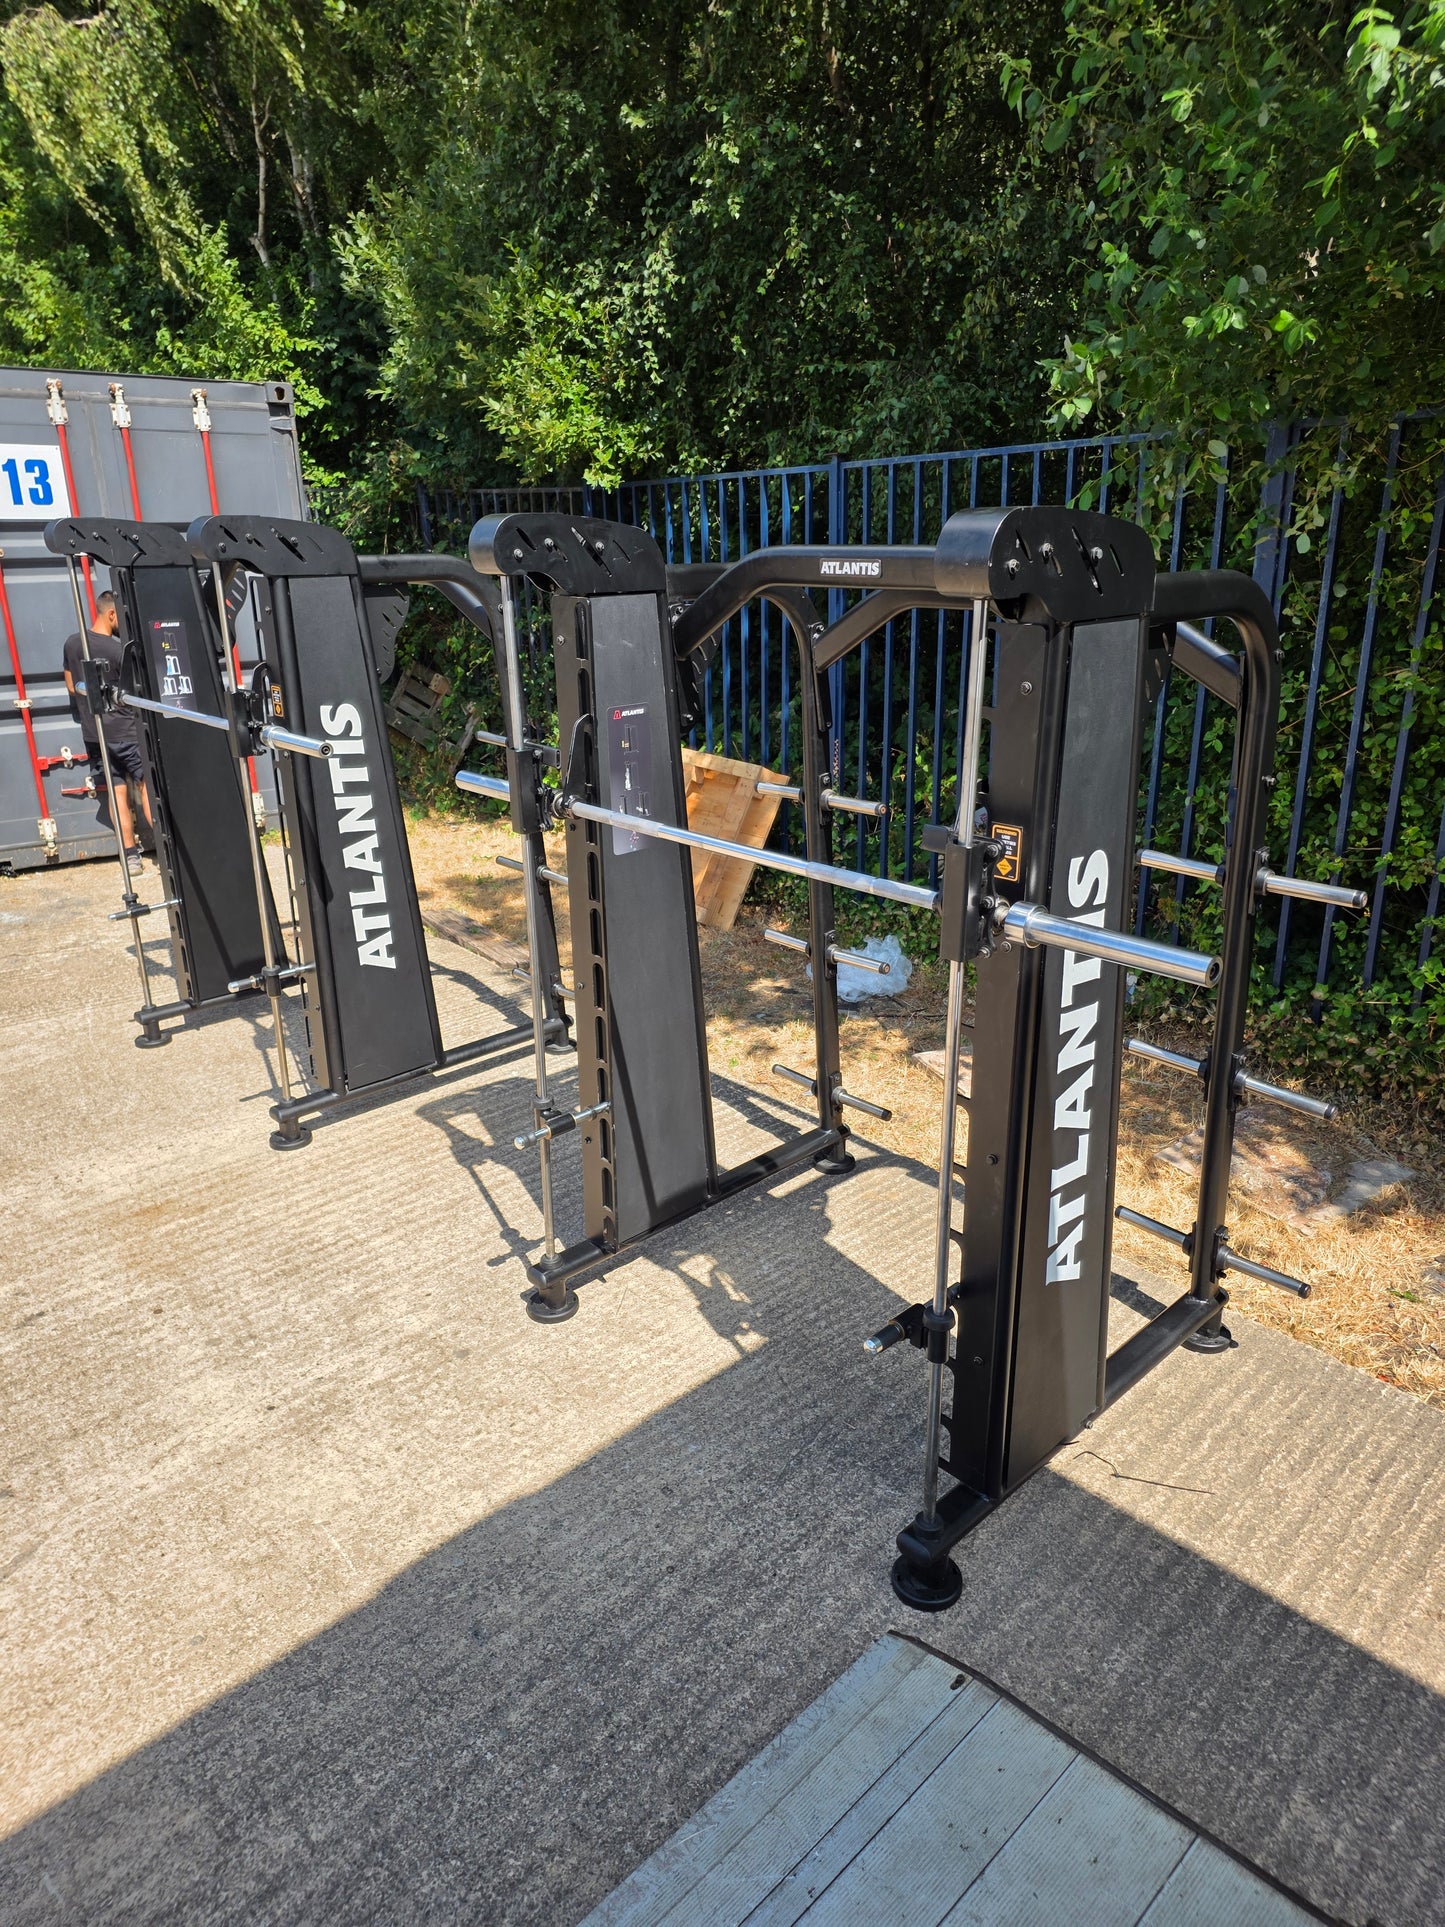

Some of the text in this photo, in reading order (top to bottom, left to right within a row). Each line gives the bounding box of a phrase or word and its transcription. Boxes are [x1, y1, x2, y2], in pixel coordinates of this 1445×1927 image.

[1, 458, 54, 506] 13
[820, 561, 880, 576] ATLANTIS
[320, 703, 397, 969] ATLANTIS
